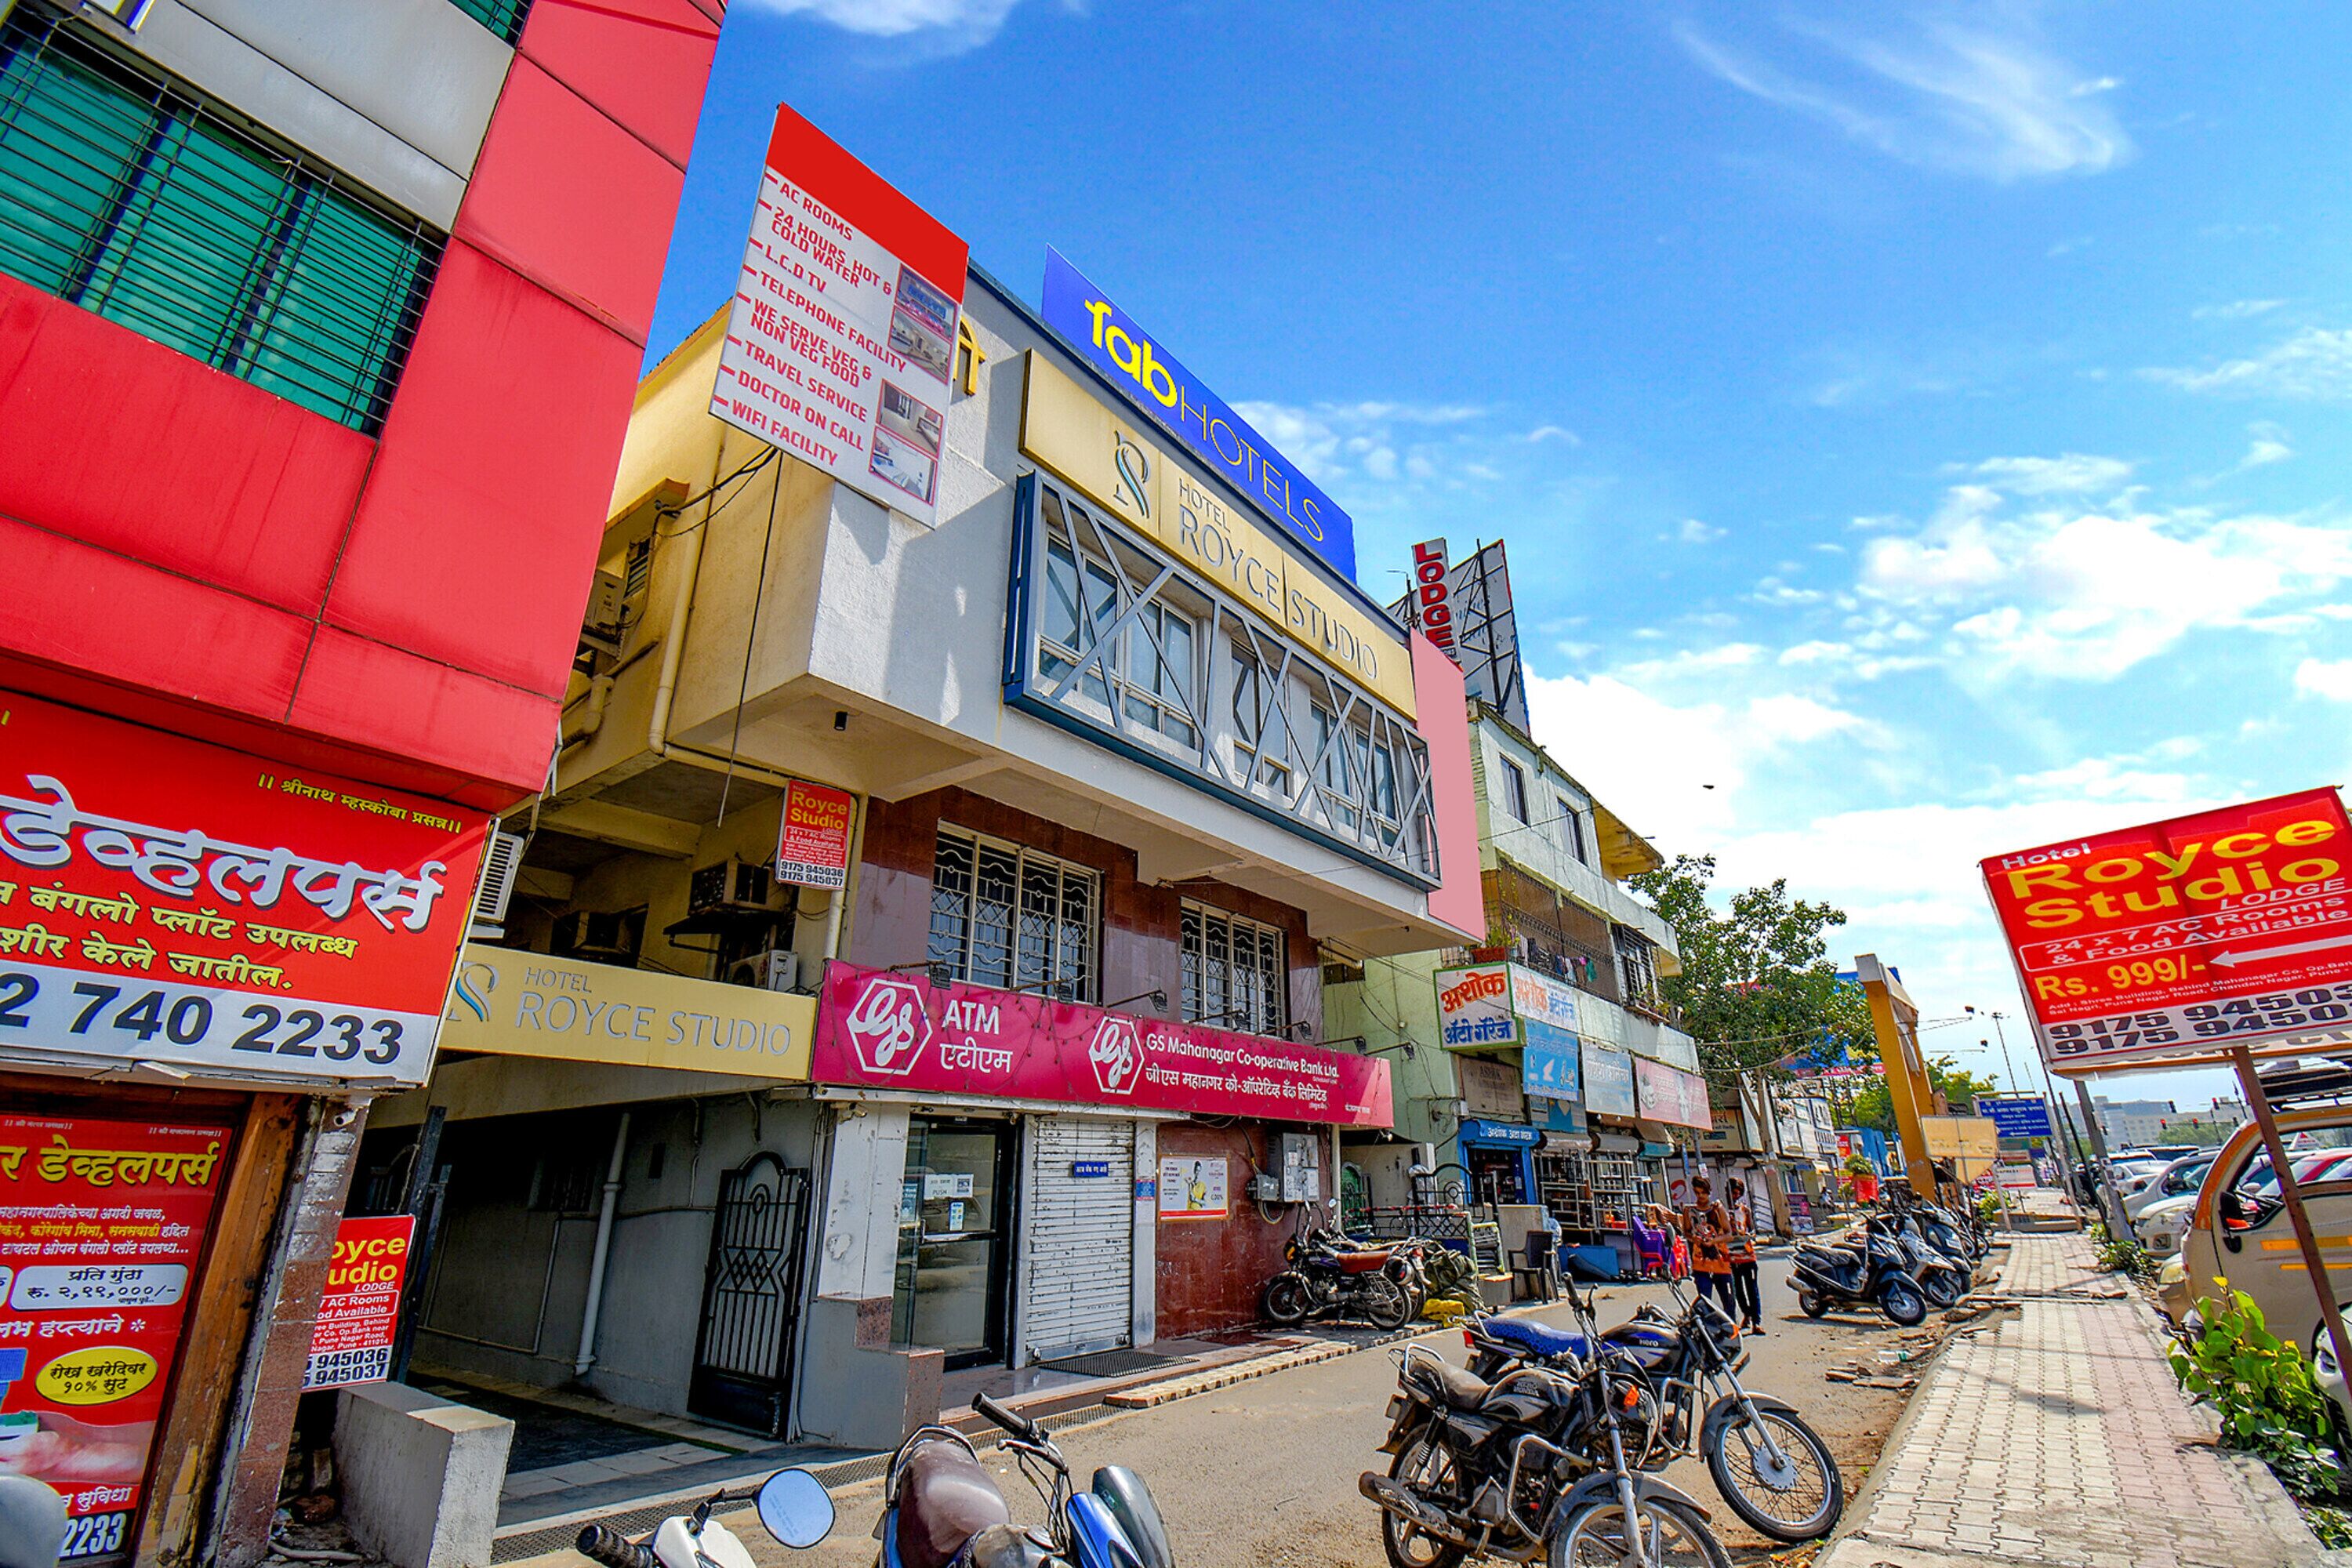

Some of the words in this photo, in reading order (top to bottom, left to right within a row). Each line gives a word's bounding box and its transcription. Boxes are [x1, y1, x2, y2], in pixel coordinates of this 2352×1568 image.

[779, 183, 800, 204] AC
[802, 197, 853, 241] ROOMS
[764, 245, 804, 279] L.C.D
[808, 270, 827, 292] TV
[771, 220, 809, 253] COLD
[812, 245, 859, 288] WATER
[774, 206, 794, 228] 24
[797, 221, 846, 264] HOURS
[853, 260, 880, 287] HOT
[882, 281, 892, 296] &
[754, 297, 775, 321] WE
[781, 314, 828, 353] SERVE
[831, 343, 859, 372] VEG
[862, 364, 872, 380] &
[760, 270, 845, 338] TELEPHONE
[850, 320, 906, 373] FACILITY
[750, 314, 785, 345] NON
[789, 336, 818, 364] VEG
[822, 353, 860, 387] FOOD
[746, 340, 803, 386] TRAVEL
[808, 374, 867, 422] SERVICE
[731, 398, 766, 430] WIFI
[771, 418, 838, 466] FACILITY
[739, 371, 800, 416] DOCTOR
[804, 406, 826, 426] ON
[829, 417, 864, 452] CALL
[1178, 477, 1231, 533] HOTEL
[1179, 506, 1282, 614] ROYCE
[1290, 590, 1378, 681] STUDIO
[1414, 543, 1453, 649] LODGE
[281, 779, 336, 804] श्रीनाथ
[791, 791, 848, 815] Royce
[790, 808, 844, 829] Studio
[0, 774, 447, 933] डेव्हलपर्स
[781, 861, 804, 872] 9175
[806, 864, 844, 877] 945036
[2002, 842, 2091, 869] Hotel
[2007, 819, 2336, 899] Royce
[780, 870, 804, 881] 9175
[806, 873, 843, 886] 945037
[2024, 857, 2340, 928] Studio
[2220, 878, 2346, 911] LODGE
[30, 880, 140, 926] बंगलो
[151, 906, 237, 941] प्लॉट
[245, 921, 358, 961] उपलब्ध
[2045, 938, 2082, 955] 24
[2094, 935, 2113, 946] x
[2122, 929, 2141, 941] 7
[2151, 918, 2202, 938] AC
[2216, 895, 2344, 924] Rooms
[2051, 953, 2076, 965] &
[2085, 937, 2173, 960] Food
[2183, 908, 2350, 944] Available
[0, 923, 71, 959] शीर
[81, 930, 156, 971] केले
[167, 951, 293, 991] जातील.
[2034, 974, 2099, 1000] Rs.
[2107, 954, 2206, 989] 999/-
[524, 967, 593, 993] HOTEL
[1440, 971, 1506, 1014] अशोक
[2080, 997, 2111, 1007] Shree
[2114, 989, 2166, 1002] Building,
[2169, 983, 2210, 994] Behind
[2212, 973, 2280, 989] Mahanagar
[2306, 960, 2352, 971] Op.Ban
[2104, 999, 2140, 1008] Pune
[2143, 994, 2171, 1004] Nagar
[2210, 979, 2264, 993] Chandan
[2309, 968, 2341, 978] Pune
[71, 981, 213, 1046] 740
[231, 1004, 405, 1065] 2233
[514, 991, 655, 1043] ROYCE
[665, 1010, 791, 1056] STUDIO
[942, 1000, 1000, 1035] ATM
[2049, 1011, 2170, 1040] 9175
[2055, 1026, 2180, 1055] 9175
[2194, 1002, 2352, 1037] 9450
[939, 1036, 1013, 1074] एटीएम
[1146, 1033, 1166, 1052] GS
[1168, 1035, 1236, 1065] Mahanagar
[1236, 1048, 1299, 1073] Co-operative
[1301, 1058, 1323, 1076] Bank
[1182, 1072, 1222, 1091] महानगर
[1283, 1080, 1296, 1098] बँक
[1298, 1083, 1327, 1102] लिमिटेड
[37, 1134, 220, 1186] डेव्हलपर्स
[43, 1240, 78, 1255] ओपन
[331, 1237, 406, 1264] oyce
[68, 1267, 106, 1281] प्रति
[111, 1266, 144, 1284] गुंठा
[328, 1261, 397, 1286] udio
[354, 1281, 395, 1293] LODGE
[317, 1308, 332, 1319] od
[335, 1305, 388, 1318] Available
[328, 1298, 346, 1308] AC
[349, 1294, 390, 1306] Rooms
[363, 1317, 390, 1326] Behind
[317, 1348, 388, 1369] 945036
[319, 1336, 338, 1345] Pune
[50, 1364, 82, 1379] रोख
[103, 1378, 128, 1395] सुट
[315, 1363, 387, 1385] 945037
[78, 1486, 132, 1512] सुविधा
[59, 1512, 127, 1557] 2233
